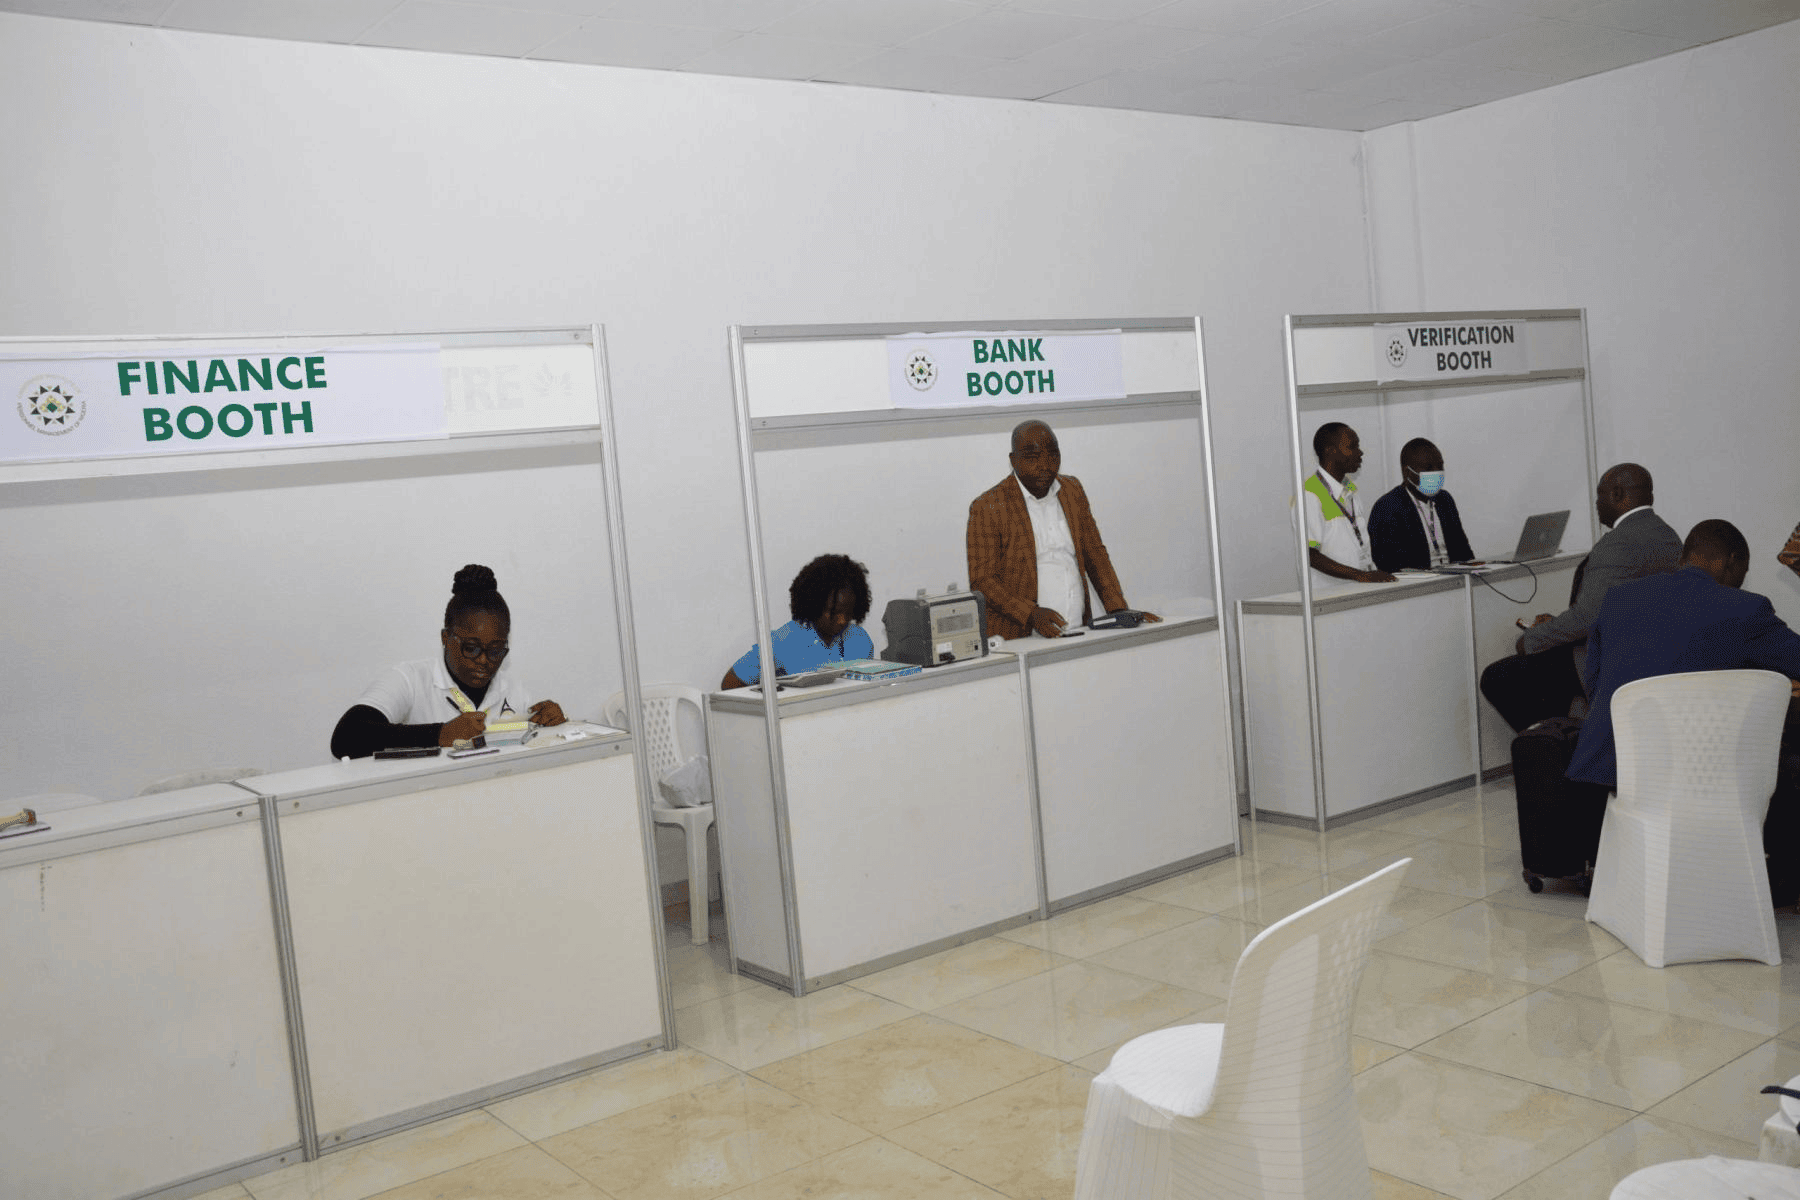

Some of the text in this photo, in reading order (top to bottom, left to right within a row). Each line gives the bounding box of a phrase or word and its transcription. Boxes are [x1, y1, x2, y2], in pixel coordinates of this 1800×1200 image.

[1407, 325, 1515, 347] VERIFICATION
[973, 338, 1044, 363] BANK
[1436, 350, 1492, 371] BOOTH
[118, 356, 327, 395] FINANCE
[966, 369, 1055, 397] BOOTH
[143, 401, 314, 442] BOOTH
